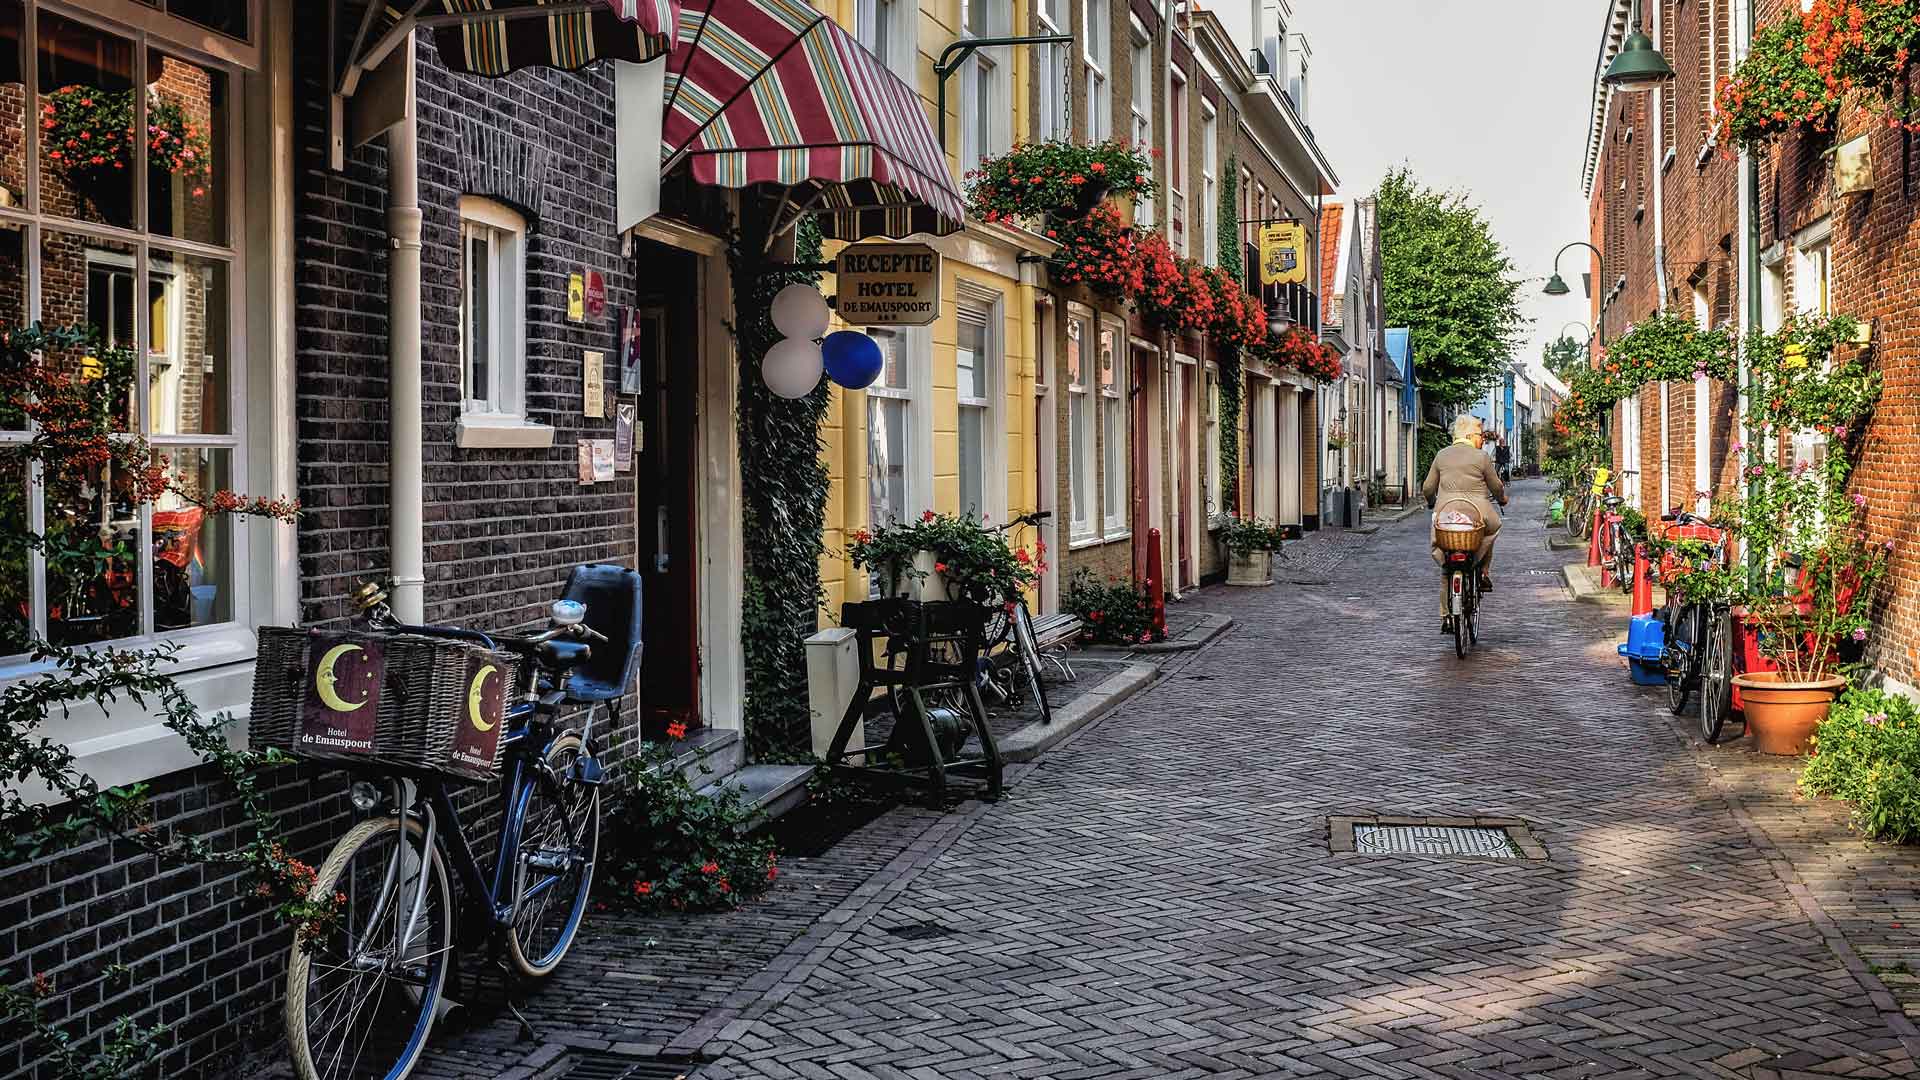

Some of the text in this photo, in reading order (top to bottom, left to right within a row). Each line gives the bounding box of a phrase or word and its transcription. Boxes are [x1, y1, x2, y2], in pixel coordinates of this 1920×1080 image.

[844, 254, 933, 273] RECEPTIE
[858, 282, 917, 297] HOTEL
[843, 301, 933, 313] DE EMAUSPOORT
[327, 727, 347, 737] Hotel
[302, 733, 373, 749] de Emauspoort
[452, 750, 461, 760] de
